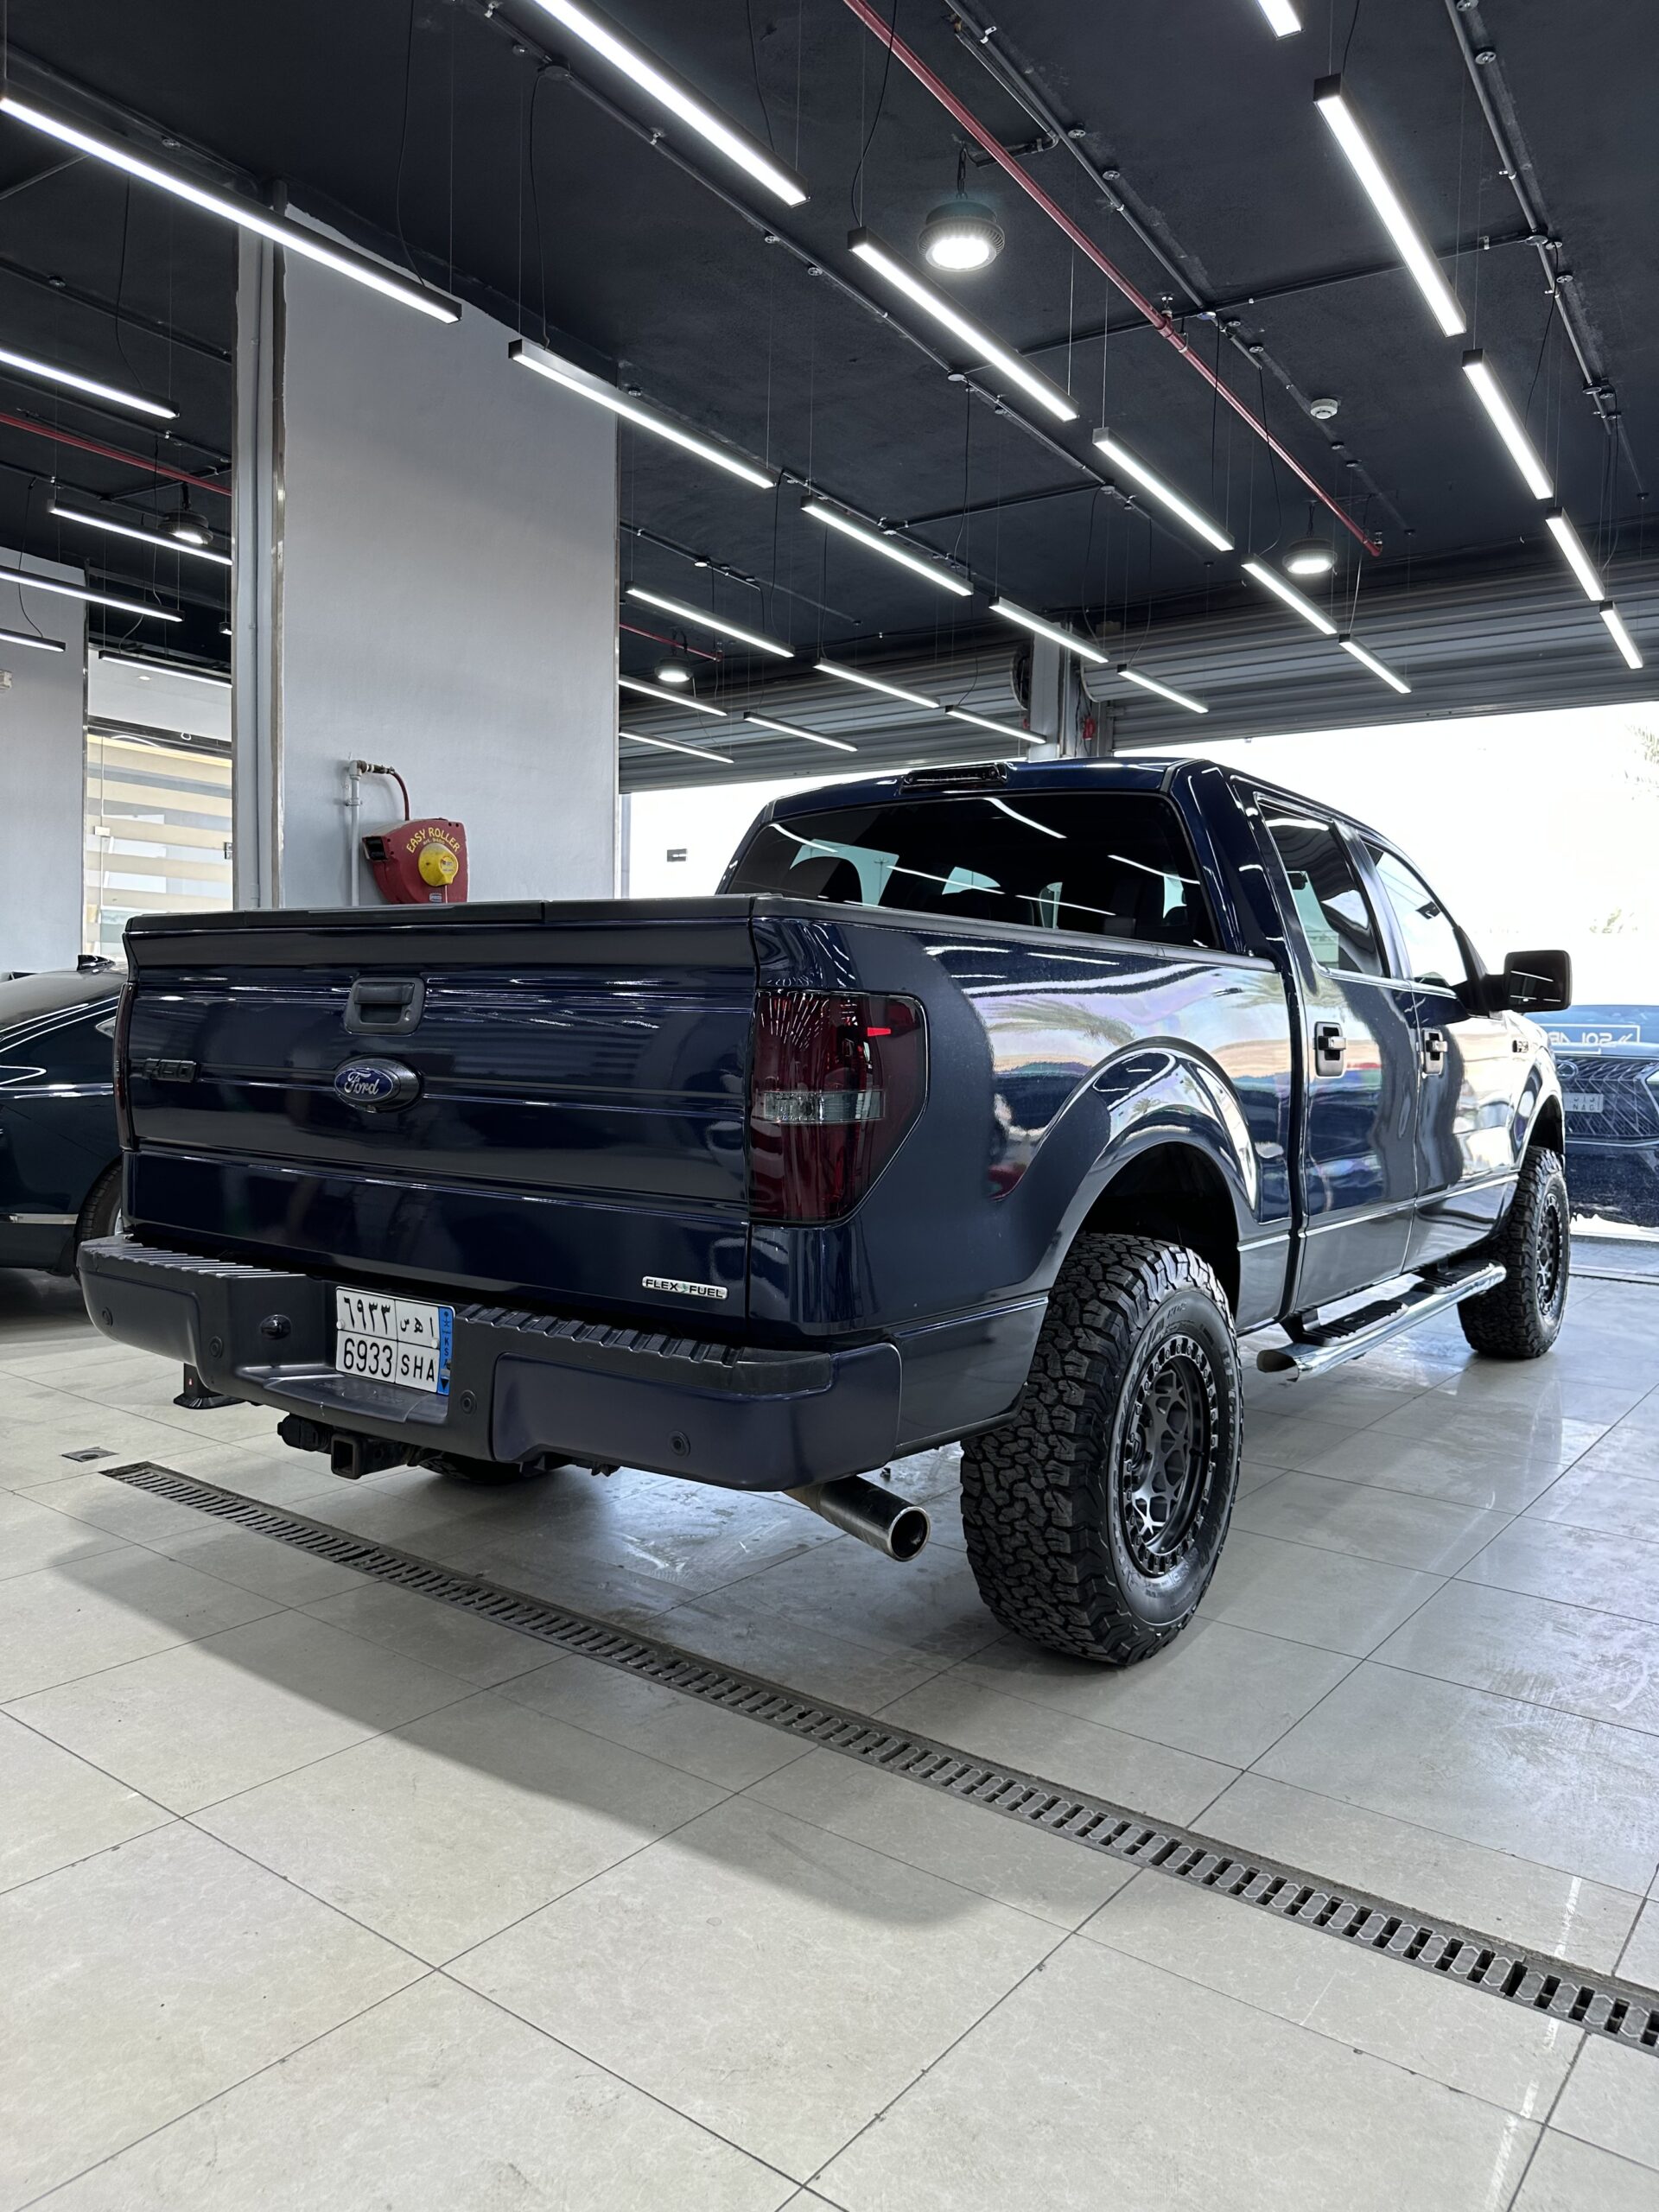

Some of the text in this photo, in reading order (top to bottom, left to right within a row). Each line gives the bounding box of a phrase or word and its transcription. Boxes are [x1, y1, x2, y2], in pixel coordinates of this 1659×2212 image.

[406, 827, 461, 854] EASY ROLLER
[344, 1071, 380, 1096] Ford
[645, 1279, 723, 1298] FLEX FUEL
[343, 1338, 435, 1382] 6933 SHA
